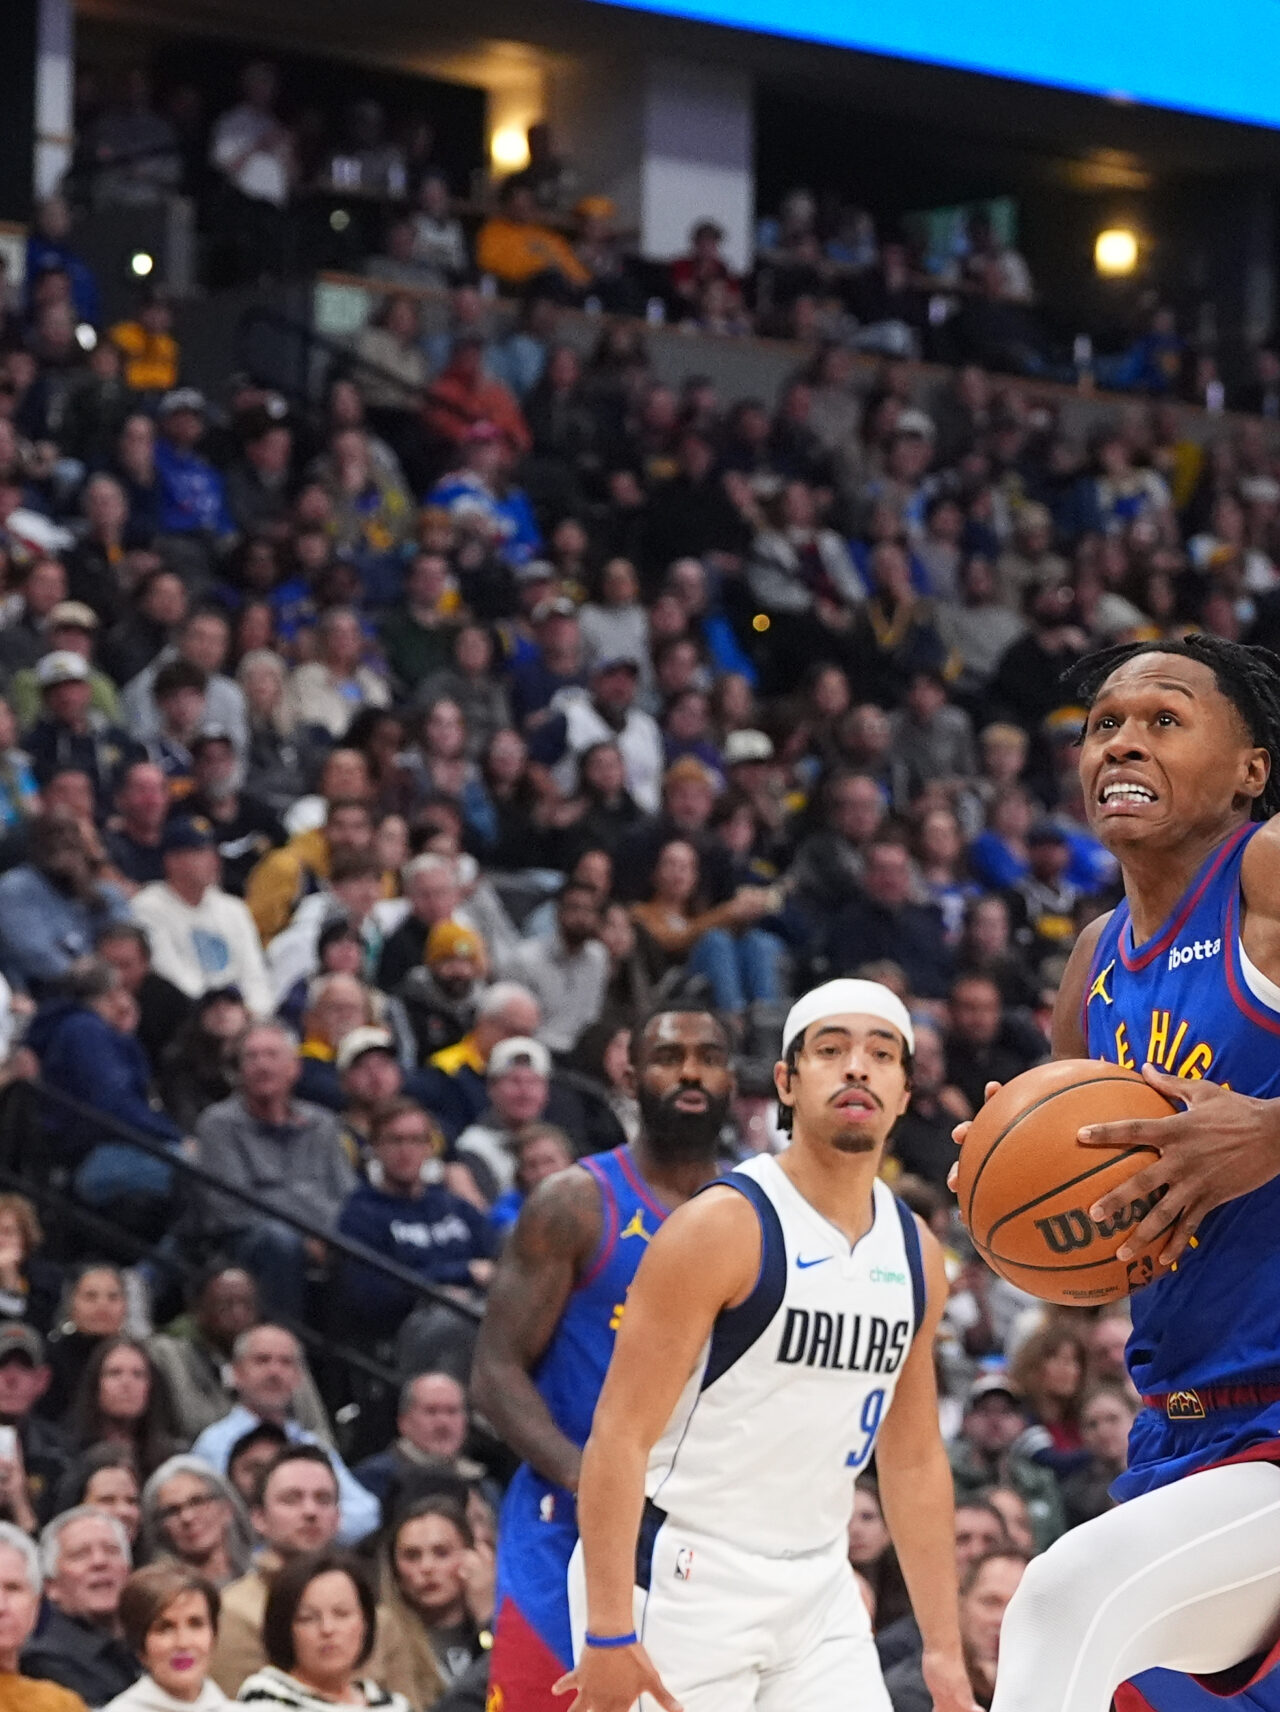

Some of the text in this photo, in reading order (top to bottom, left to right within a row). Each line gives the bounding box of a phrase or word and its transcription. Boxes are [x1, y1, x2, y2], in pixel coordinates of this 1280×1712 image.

[1168, 938, 1222, 971] ibotta
[1146, 1009, 1232, 1091] HIG
[776, 1306, 909, 1374] DALLAS
[846, 1387, 885, 1468] 9
